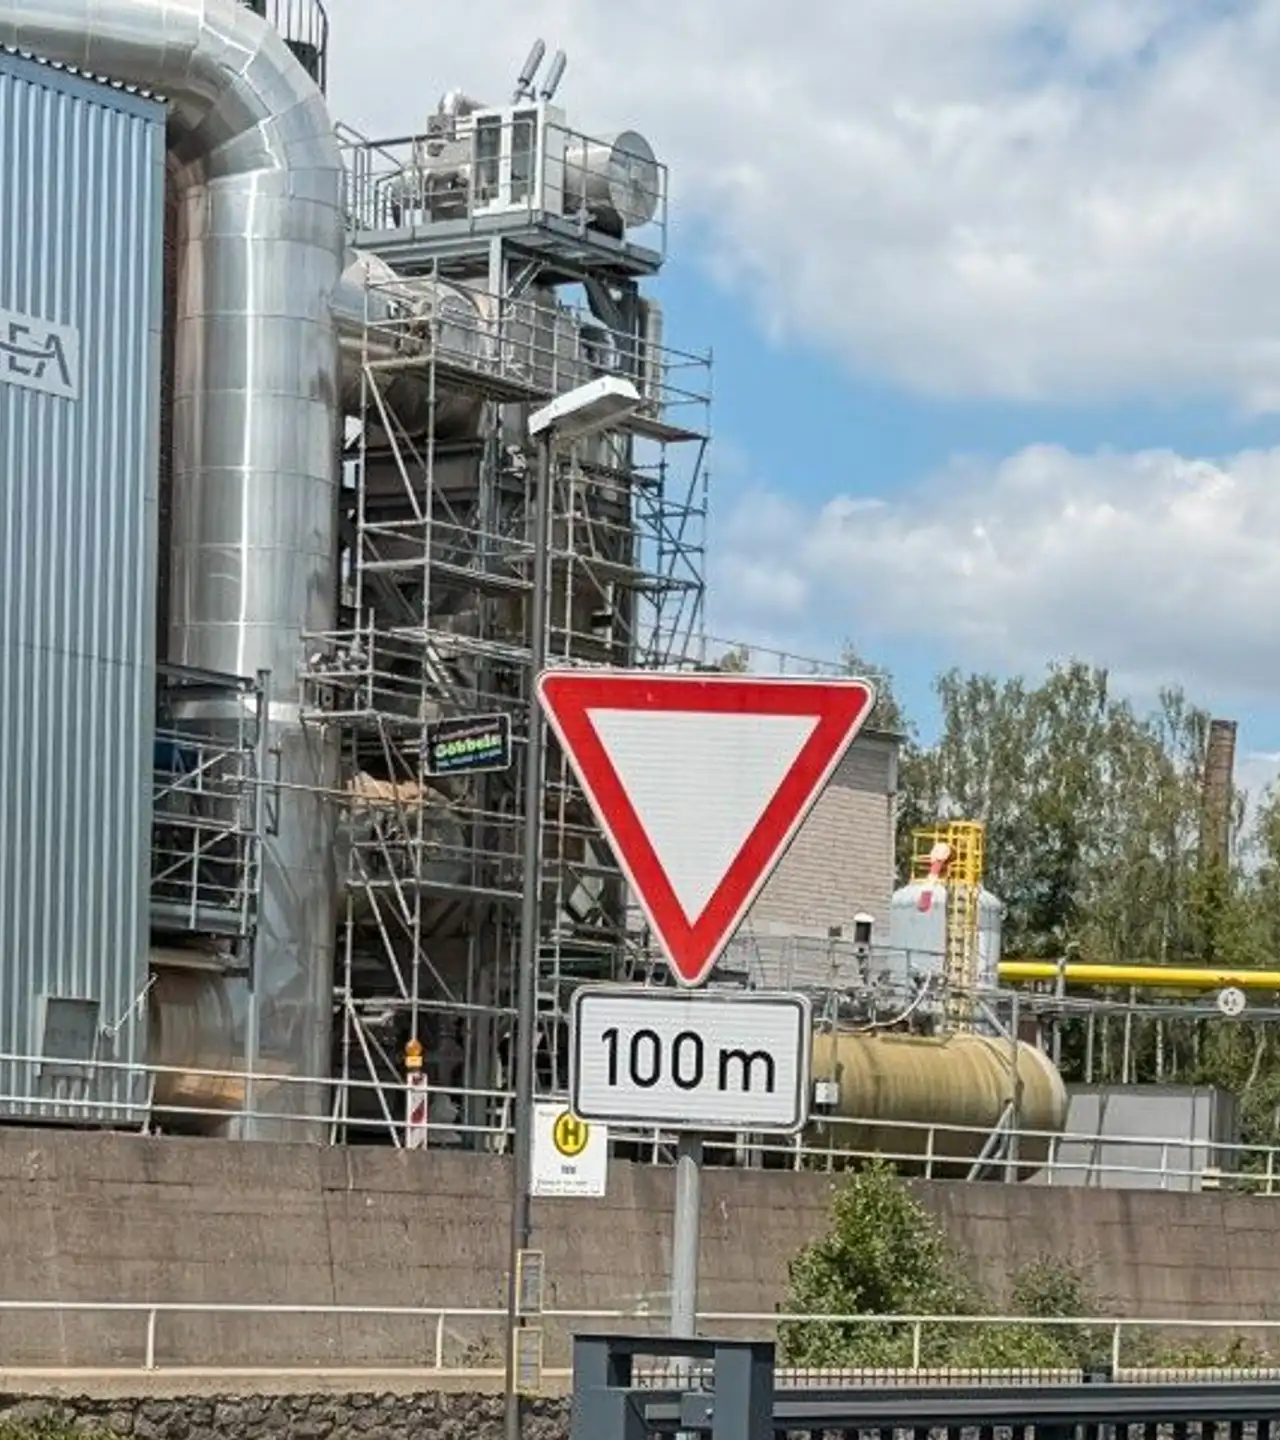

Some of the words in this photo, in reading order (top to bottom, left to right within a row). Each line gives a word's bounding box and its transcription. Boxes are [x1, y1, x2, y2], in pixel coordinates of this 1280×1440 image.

[601, 1027, 704, 1090] 100
[719, 1049, 775, 1093] m
[562, 1119, 581, 1146] H
